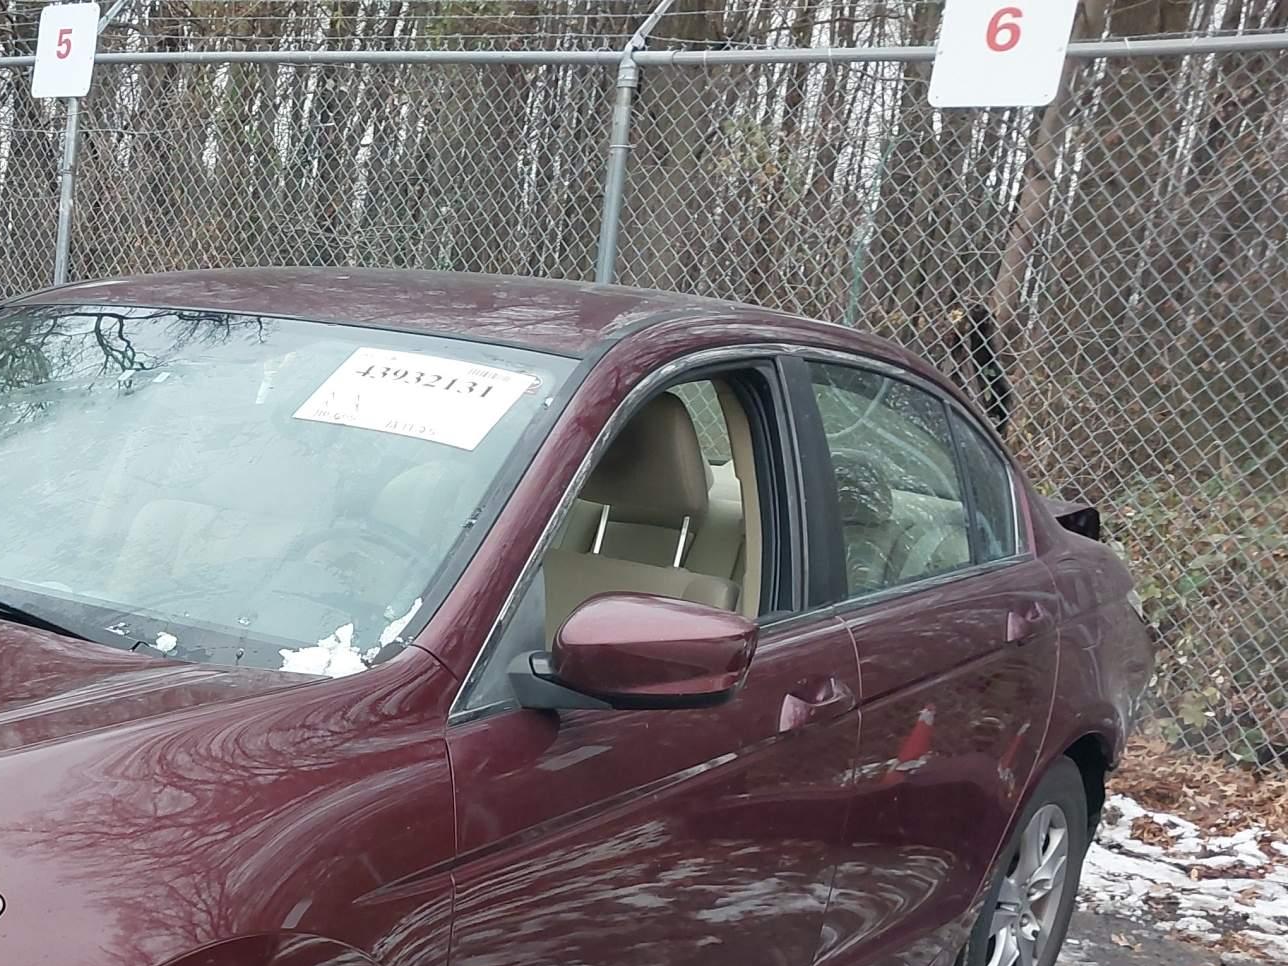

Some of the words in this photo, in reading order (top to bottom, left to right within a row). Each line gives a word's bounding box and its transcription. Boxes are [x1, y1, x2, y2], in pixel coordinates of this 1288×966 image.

[56, 29, 73, 59] 5
[986, 7, 1023, 52] 6
[356, 364, 493, 398] 43932131
